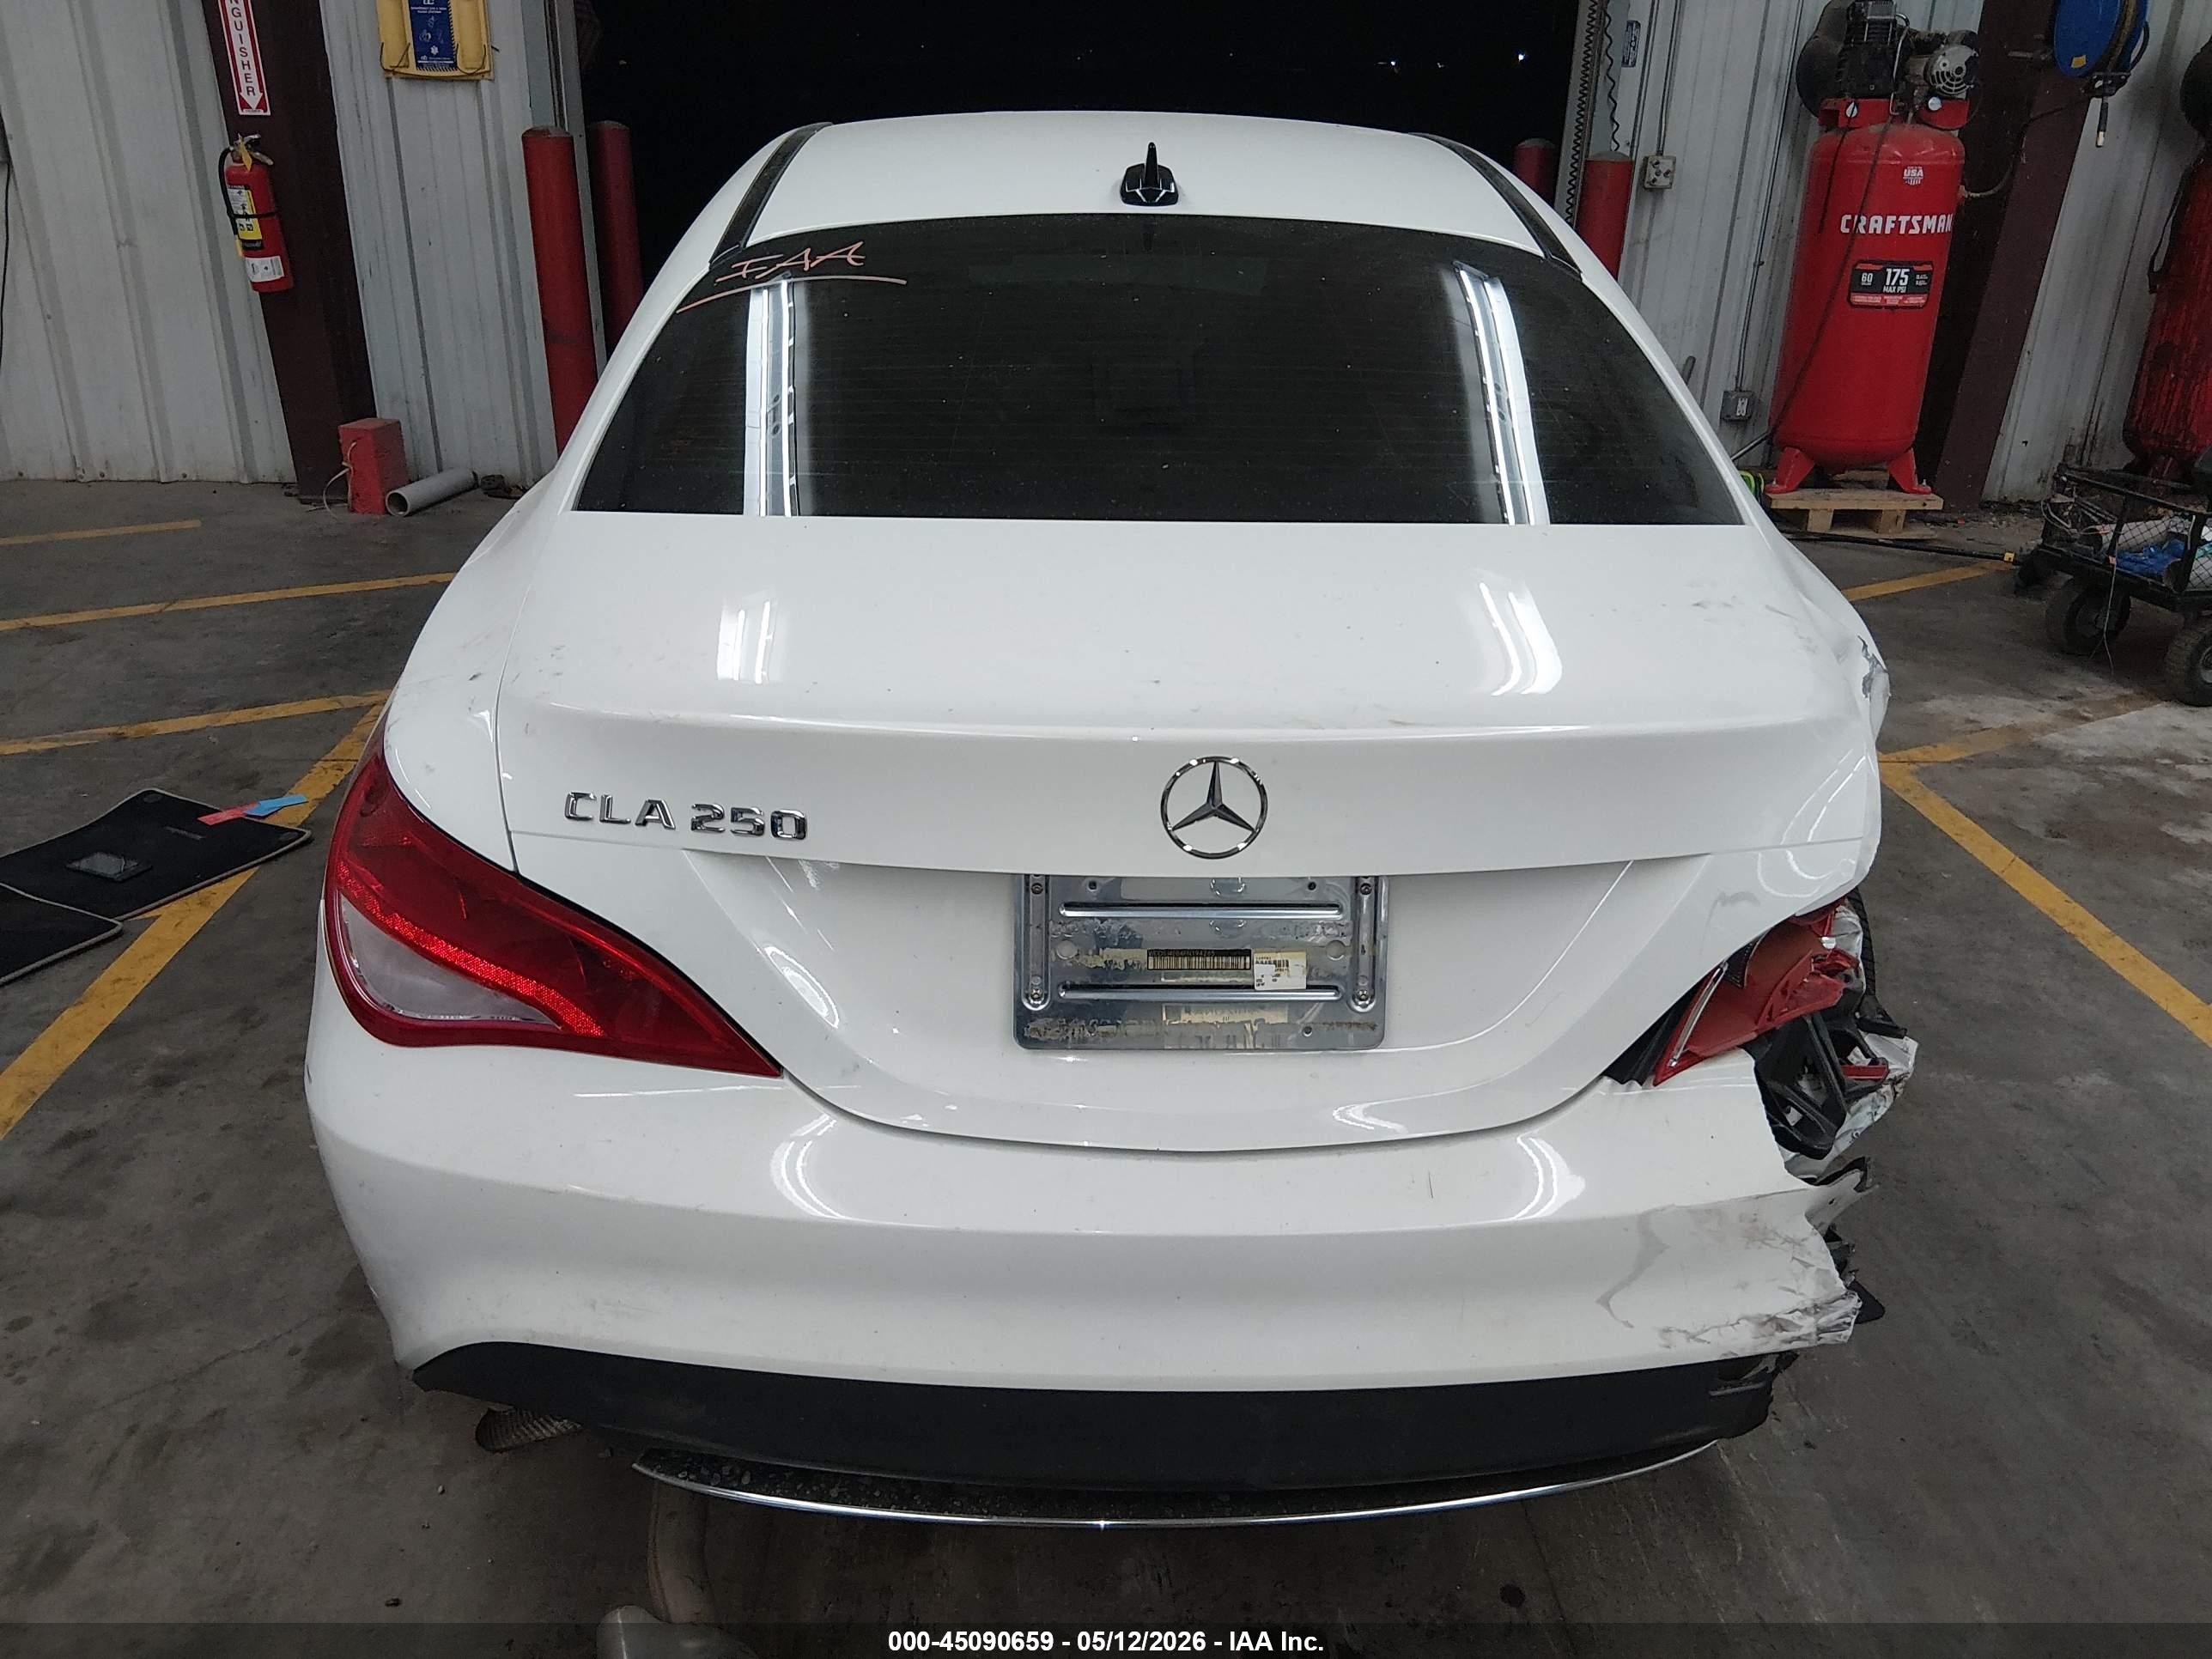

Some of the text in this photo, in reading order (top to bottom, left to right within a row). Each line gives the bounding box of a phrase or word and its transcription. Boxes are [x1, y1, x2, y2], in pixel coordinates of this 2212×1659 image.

[1841, 215, 1954, 234] CRAFTSMAN
[1862, 273, 1873, 283] 60
[1886, 269, 1910, 286] 175
[564, 791, 808, 840] CLA 250
